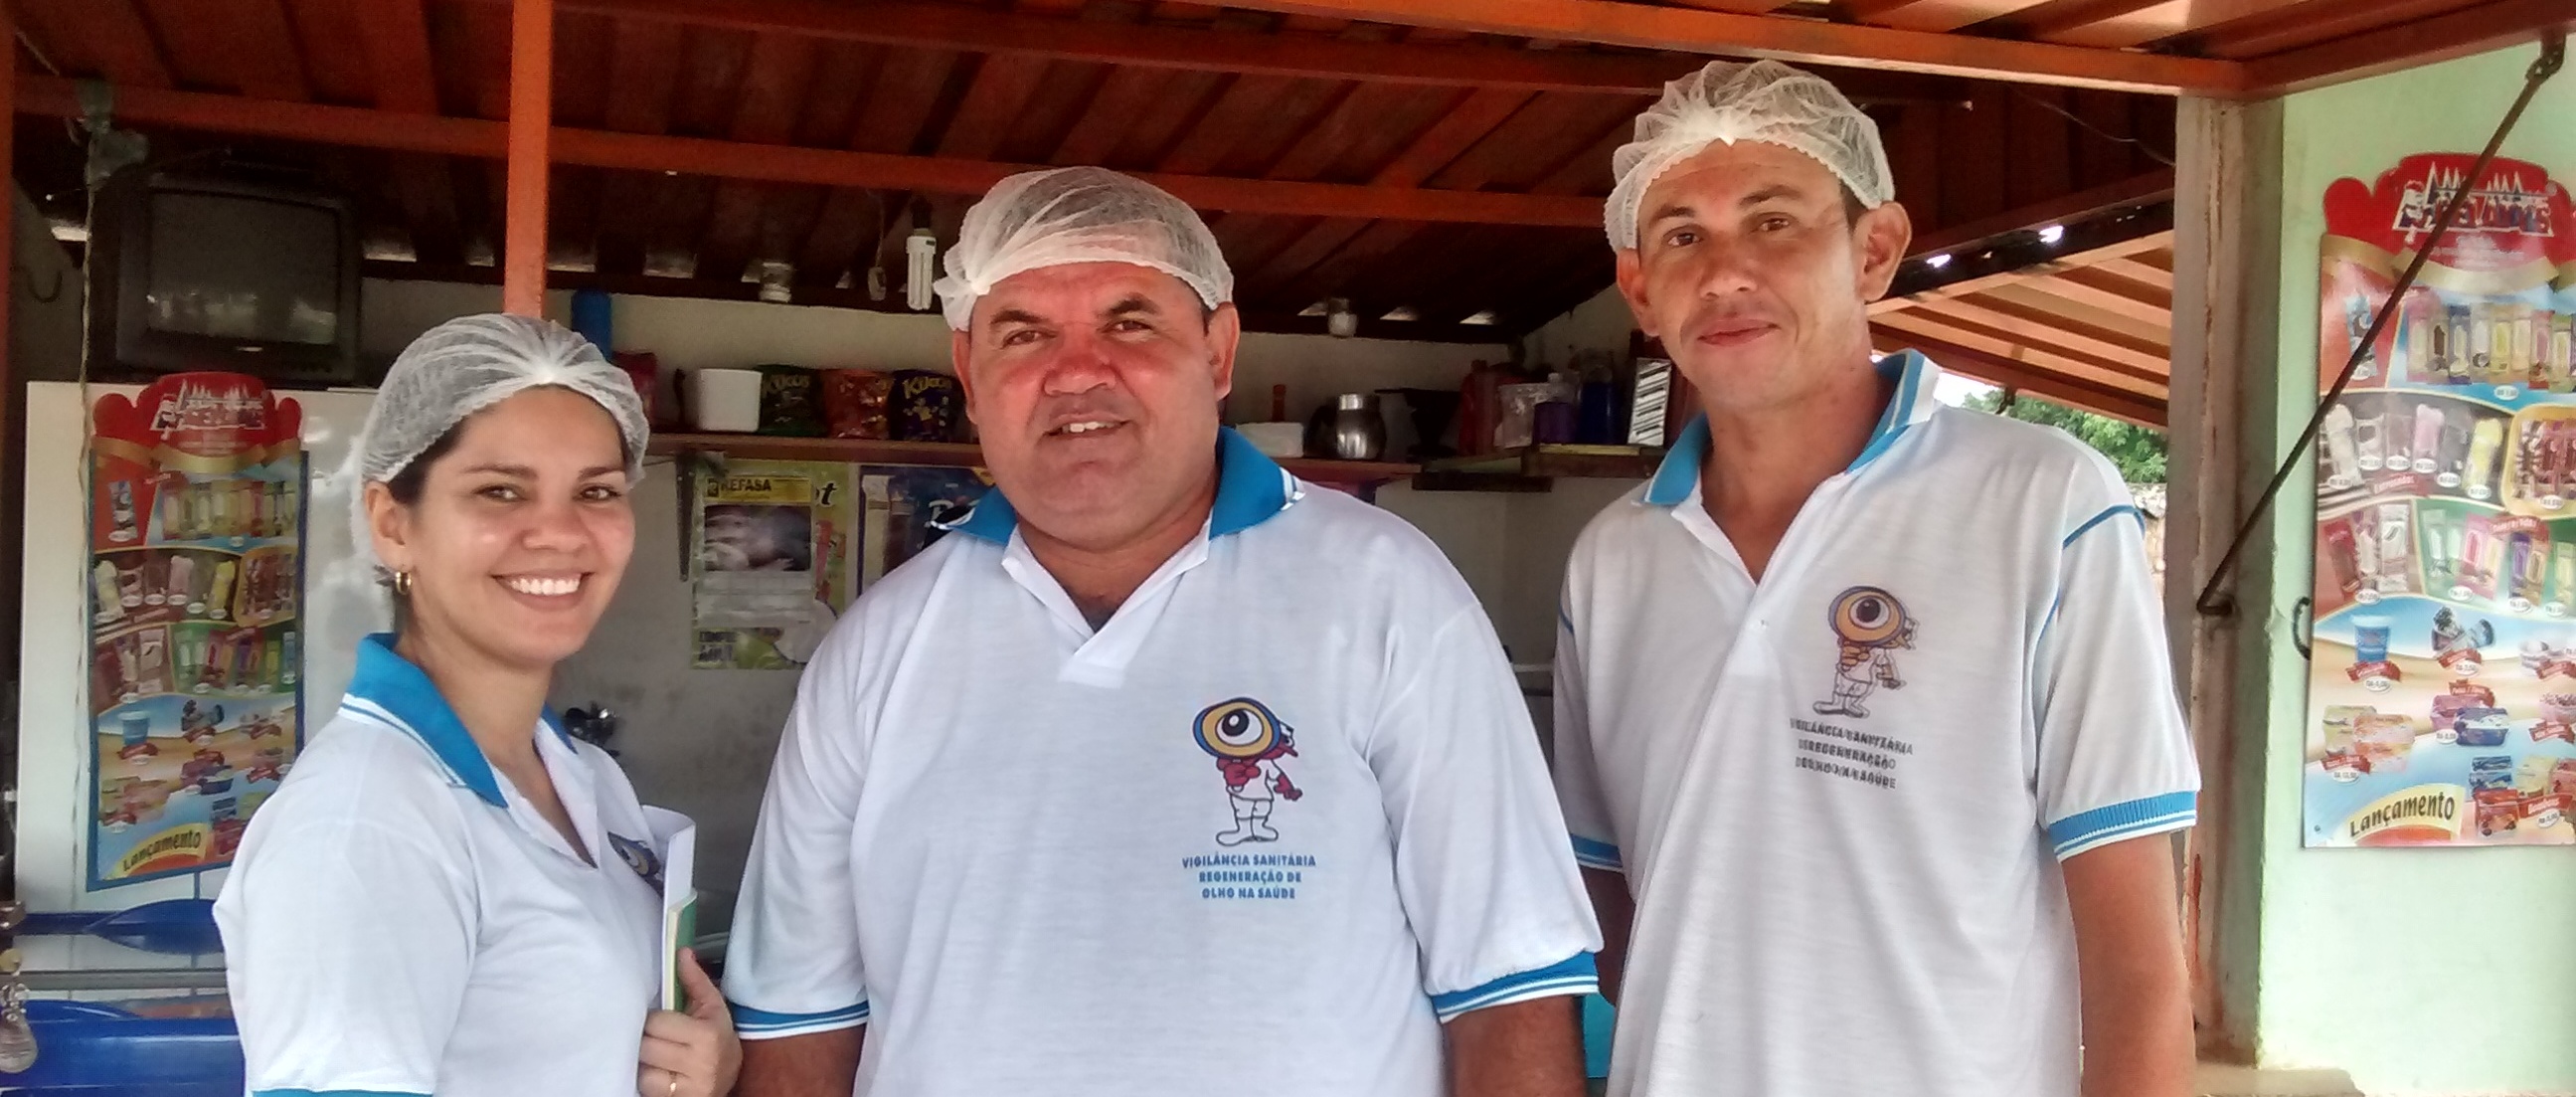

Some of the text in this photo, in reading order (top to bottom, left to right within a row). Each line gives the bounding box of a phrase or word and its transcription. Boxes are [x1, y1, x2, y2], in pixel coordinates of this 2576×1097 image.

[2349, 791, 2455, 837] Lançamento
[123, 829, 202, 871] Lançamento
[1182, 851, 1316, 868] VIGILÂNCIA SANITÁRIA
[1199, 868, 1302, 884] REGENERAÇÃO DE
[1201, 885, 1295, 899] OLHO NA SAÚDE
